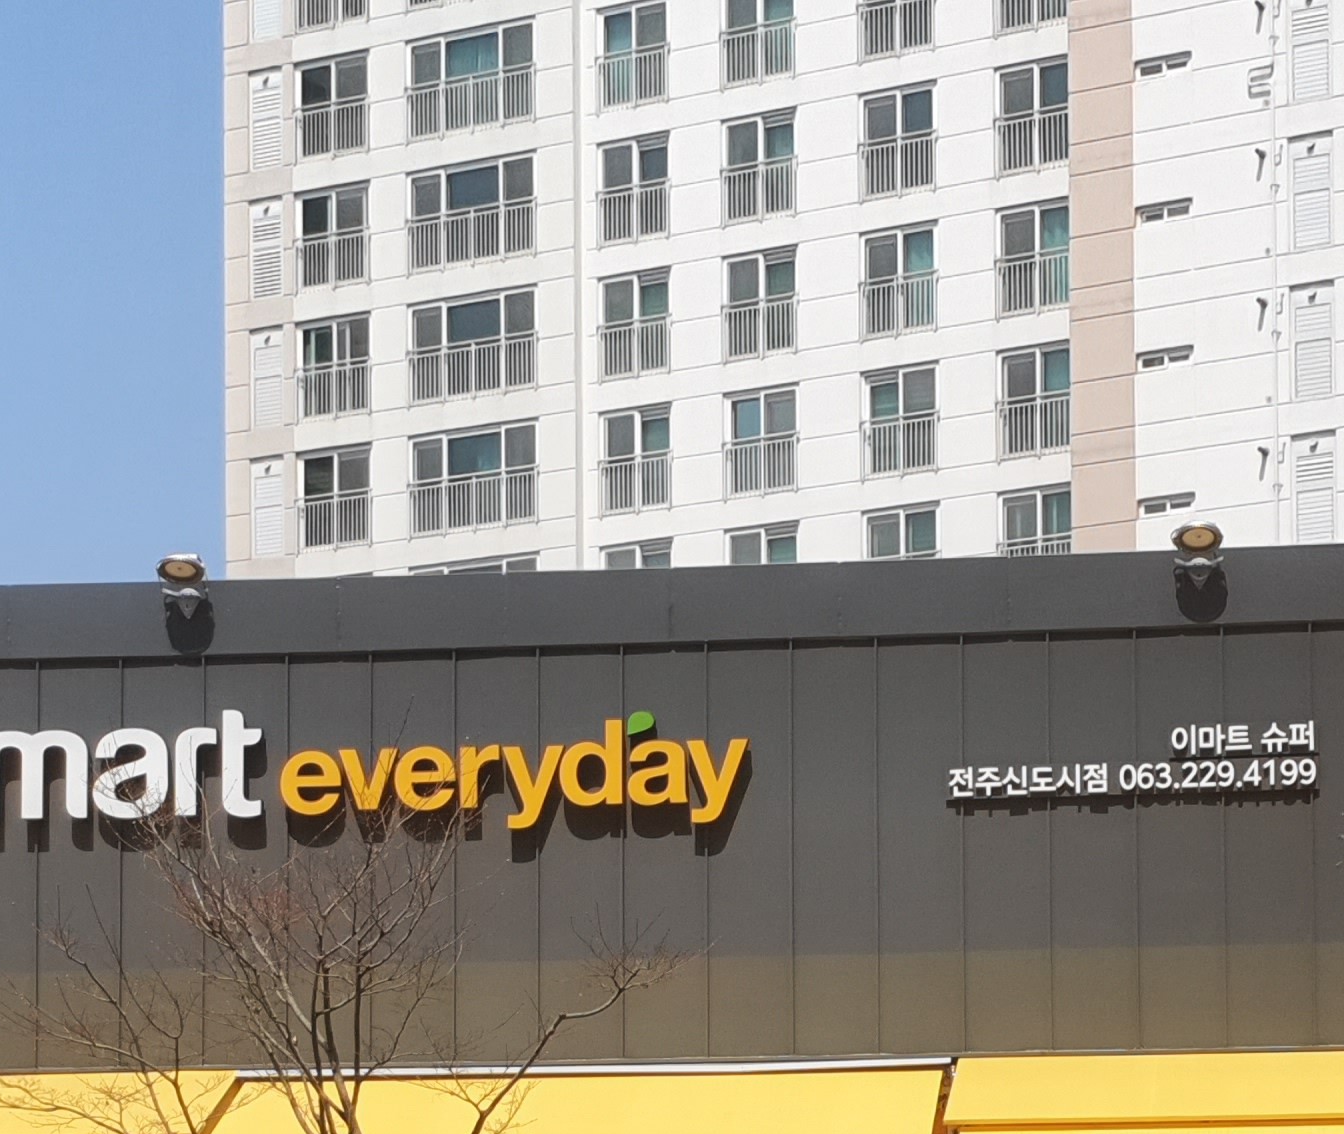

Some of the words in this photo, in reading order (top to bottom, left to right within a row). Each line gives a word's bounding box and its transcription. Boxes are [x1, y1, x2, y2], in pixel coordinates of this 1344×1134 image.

[1170, 723, 1253, 755] 이마트
[1260, 719, 1316, 752] 슈퍼
[279, 716, 750, 831] everyday
[948, 762, 1109, 798] 전주신도시점
[1118, 758, 1317, 791] 063.229.4199
